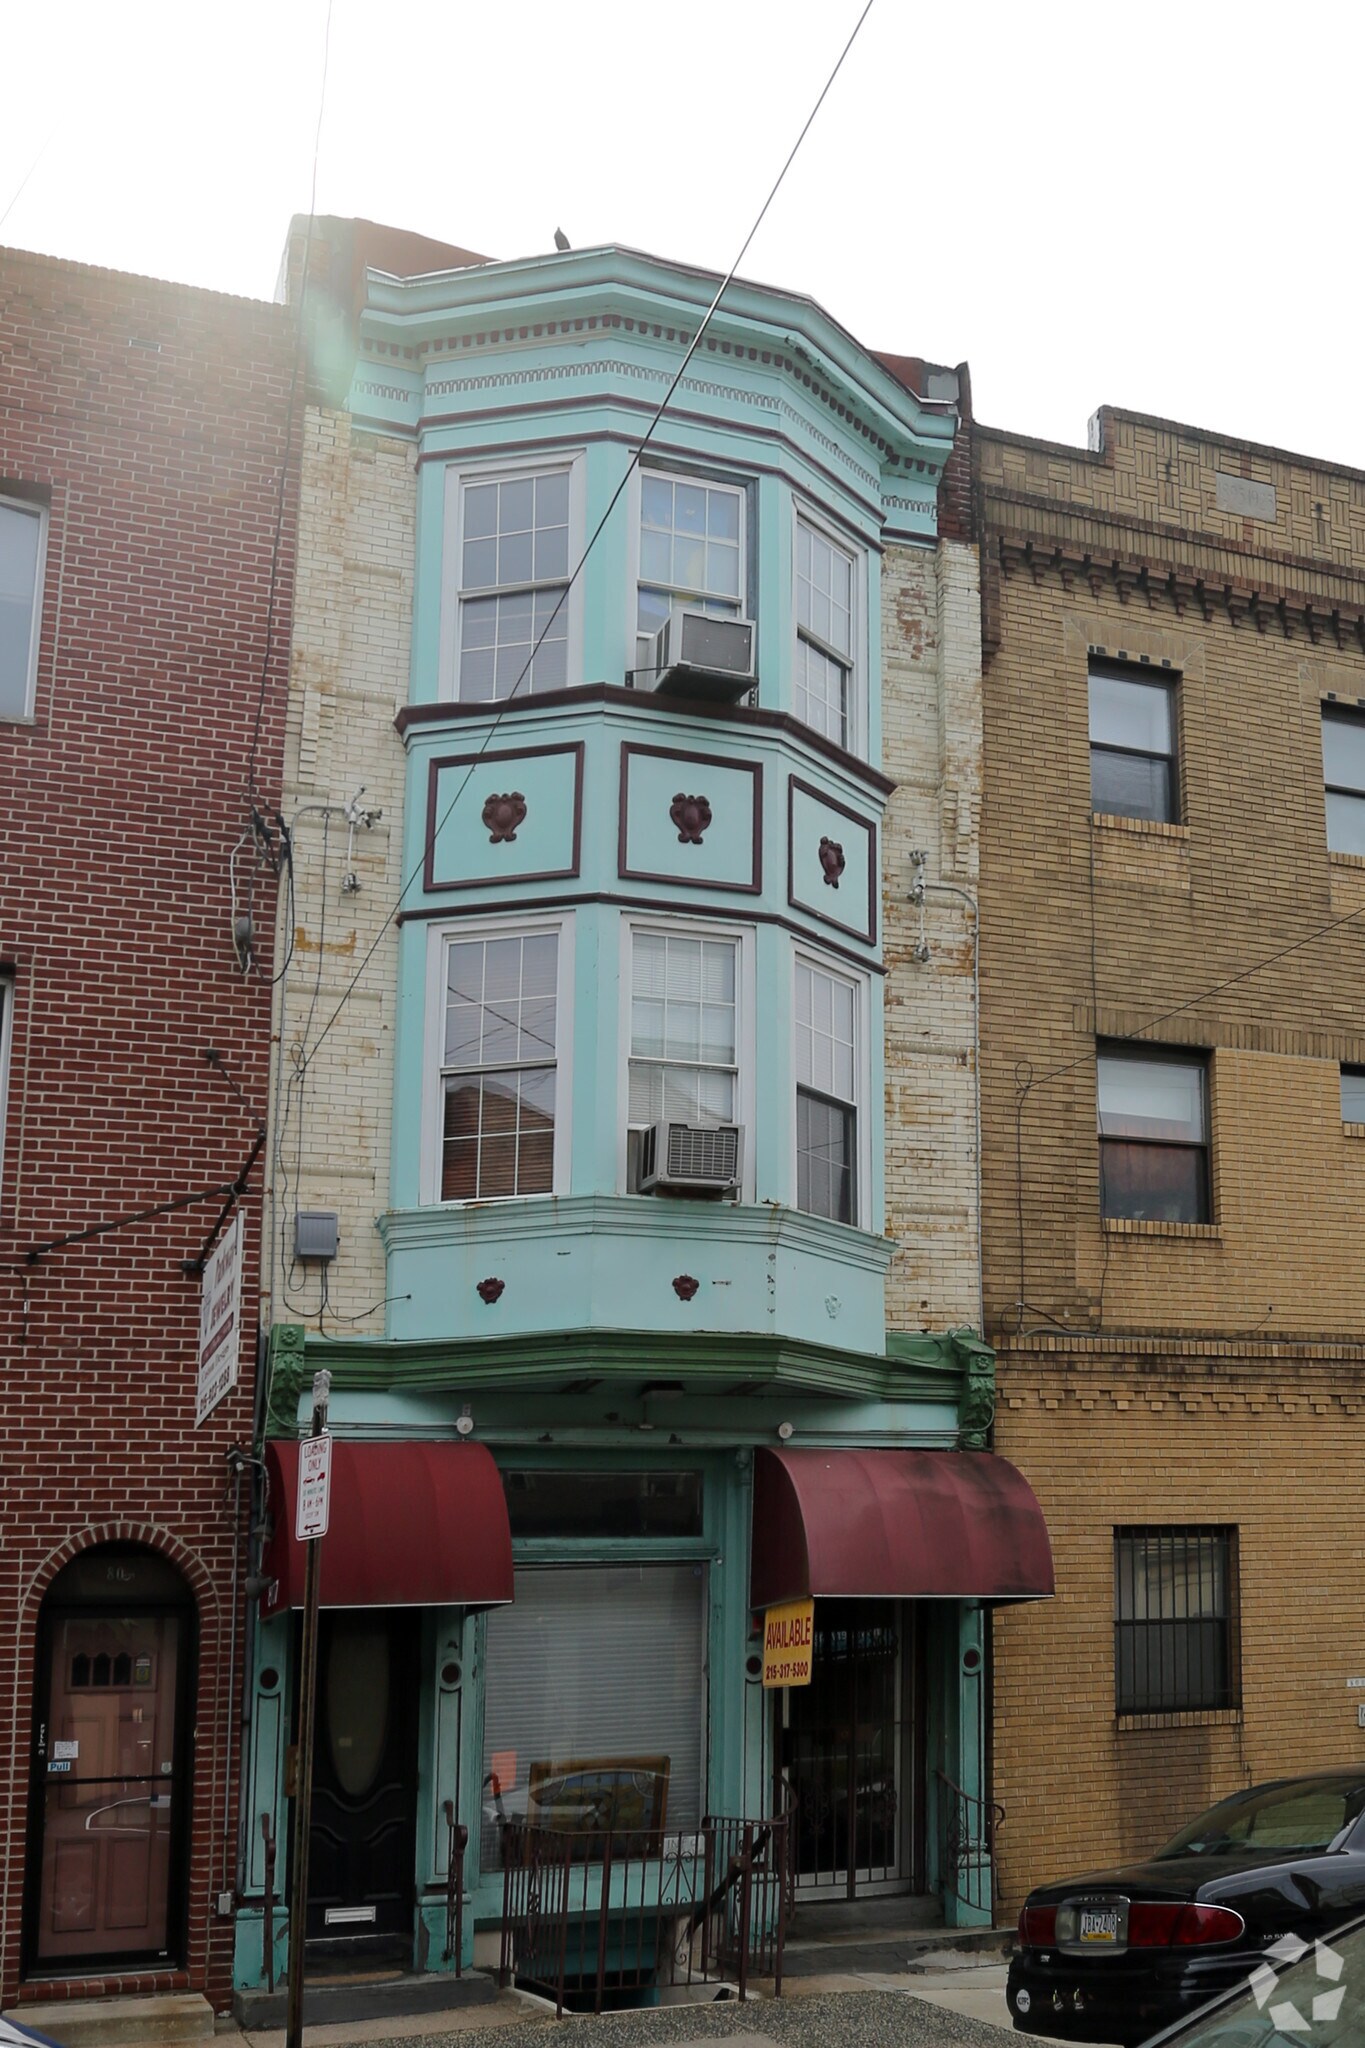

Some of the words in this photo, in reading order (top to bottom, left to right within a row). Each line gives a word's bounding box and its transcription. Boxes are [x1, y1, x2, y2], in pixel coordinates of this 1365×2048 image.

[308, 1458, 322, 1471] ONLY
[765, 1616, 811, 1650] AVAILABLE
[765, 1661, 809, 1680] 215-317-5300
[50, 1763, 69, 1771] Pull
